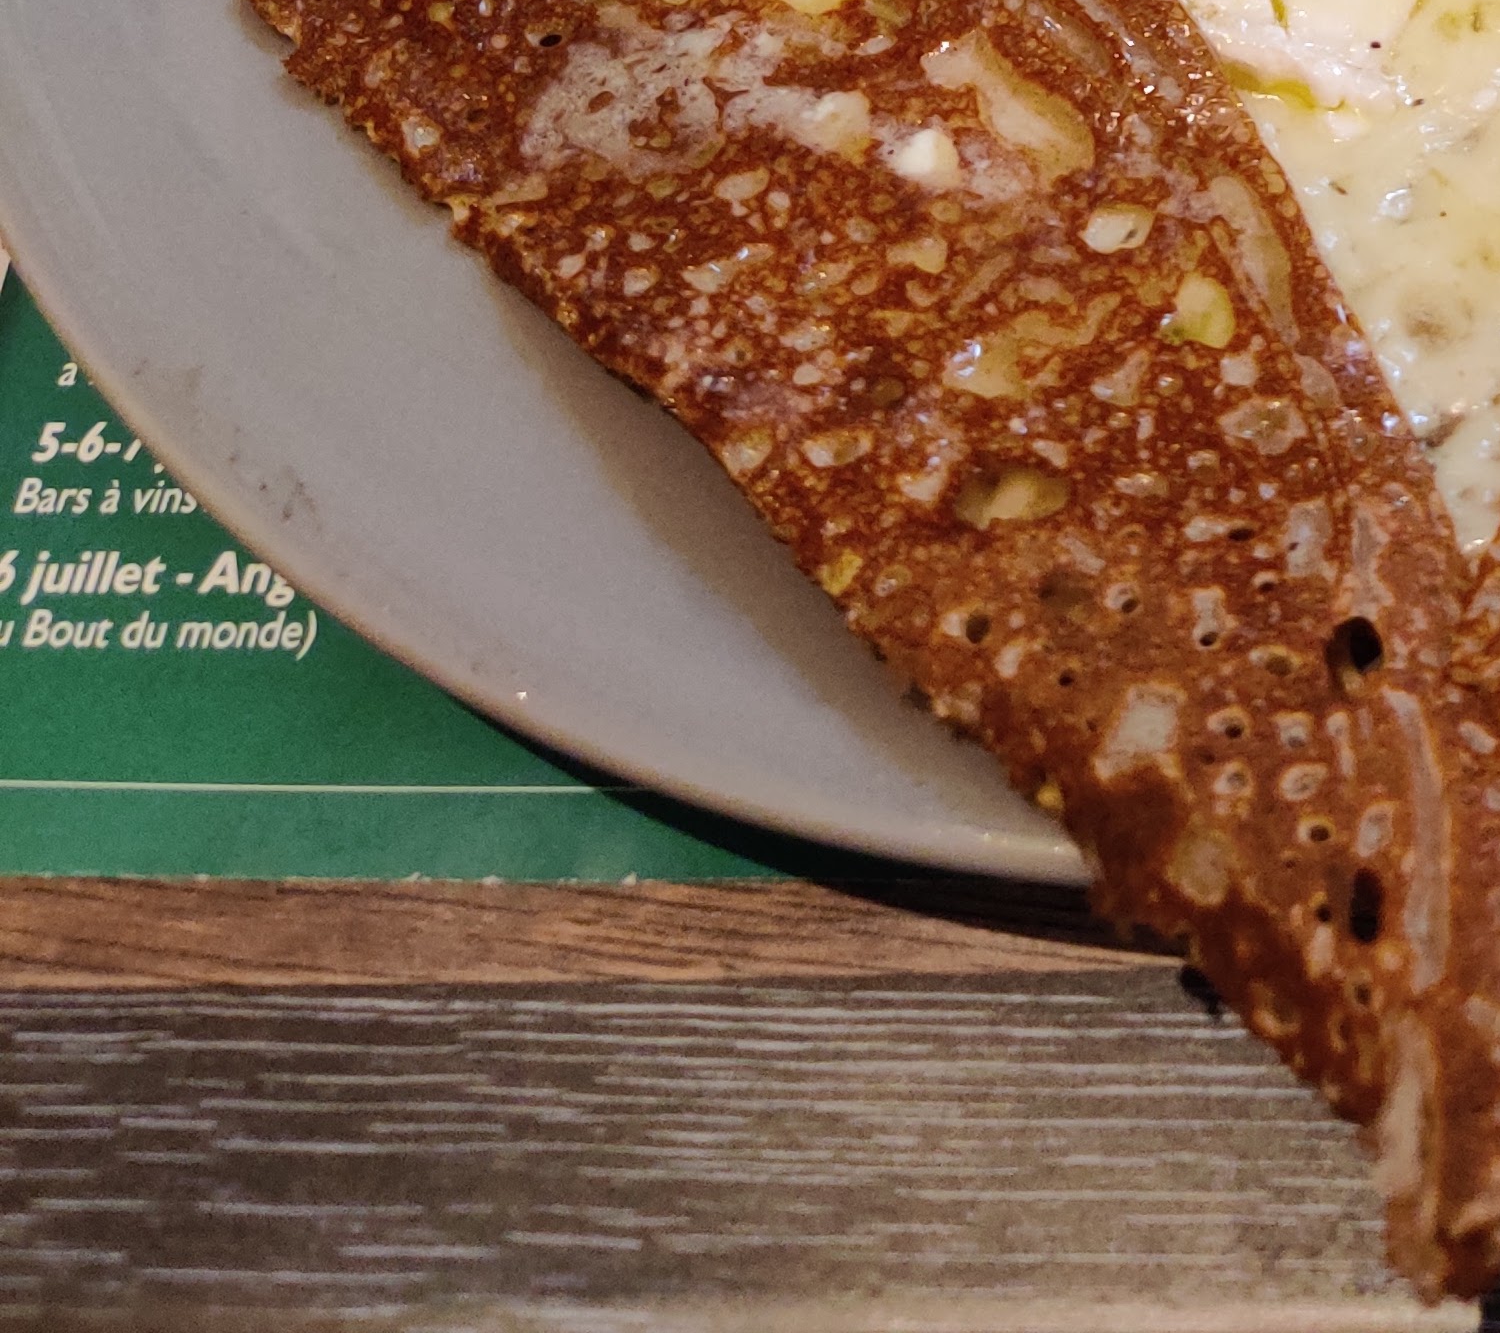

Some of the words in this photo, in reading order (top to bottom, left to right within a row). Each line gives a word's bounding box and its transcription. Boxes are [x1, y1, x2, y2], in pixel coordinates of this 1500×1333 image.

[14, 477, 92, 514] Bars
[100, 479, 120, 514] à
[21, 550, 167, 606] juillet
[22, 608, 114, 649] Bout
[121, 610, 168, 649] du
[177, 610, 318, 661] monde)
